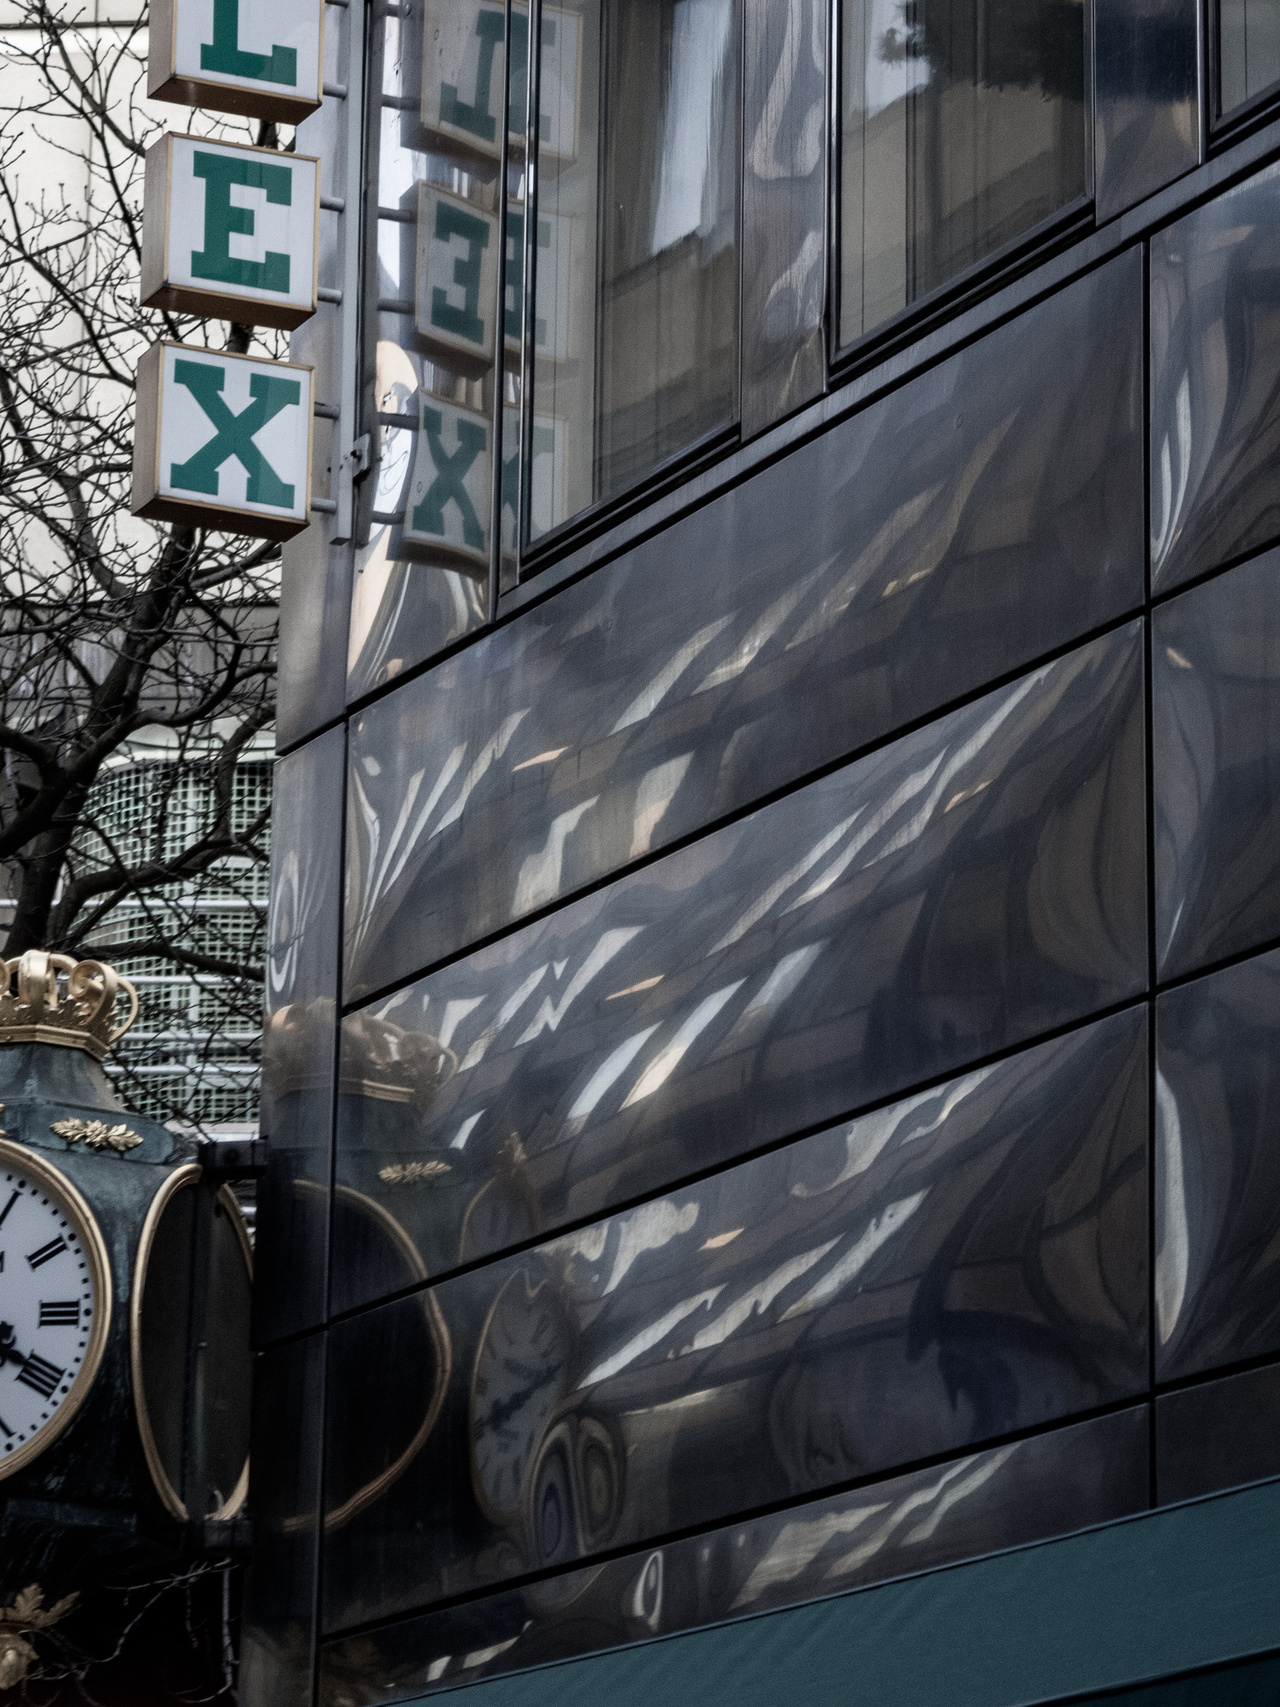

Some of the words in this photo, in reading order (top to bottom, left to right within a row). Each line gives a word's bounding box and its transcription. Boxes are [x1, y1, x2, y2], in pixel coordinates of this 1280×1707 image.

[24, 1234, 70, 1271] II
[38, 1299, 81, 1329] III
[14, 1348, 68, 1401] IIII
